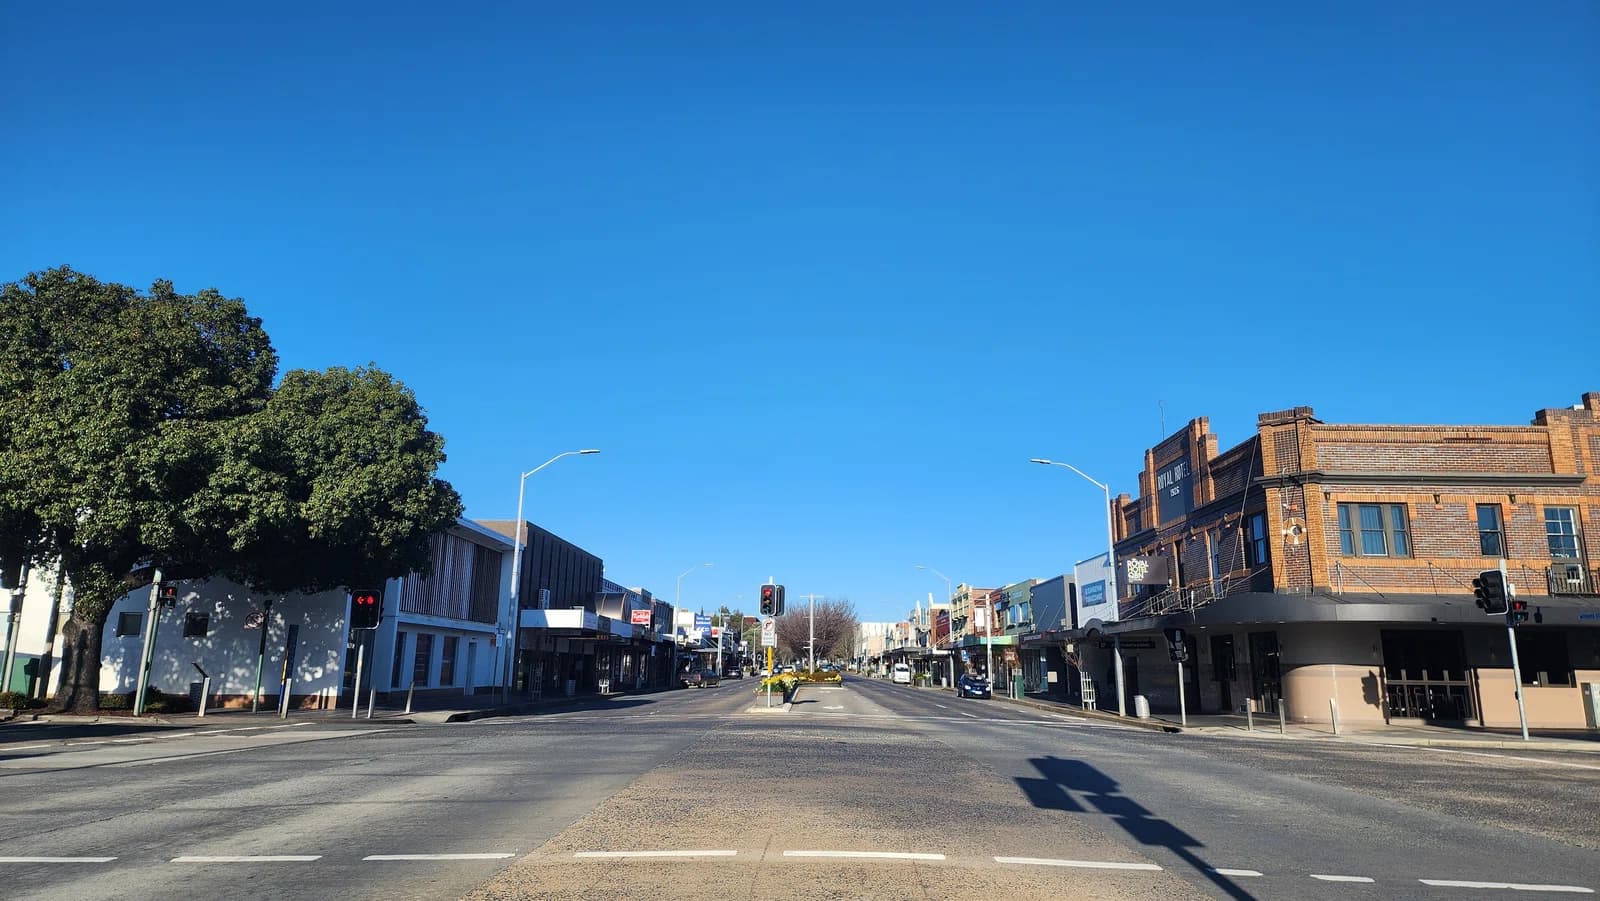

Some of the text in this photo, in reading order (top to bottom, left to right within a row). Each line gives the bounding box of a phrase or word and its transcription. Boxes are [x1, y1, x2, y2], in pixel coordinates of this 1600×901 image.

[1157, 461, 1190, 491] ROYAL HOTEL
[1127, 560, 1149, 568] ROYAL
